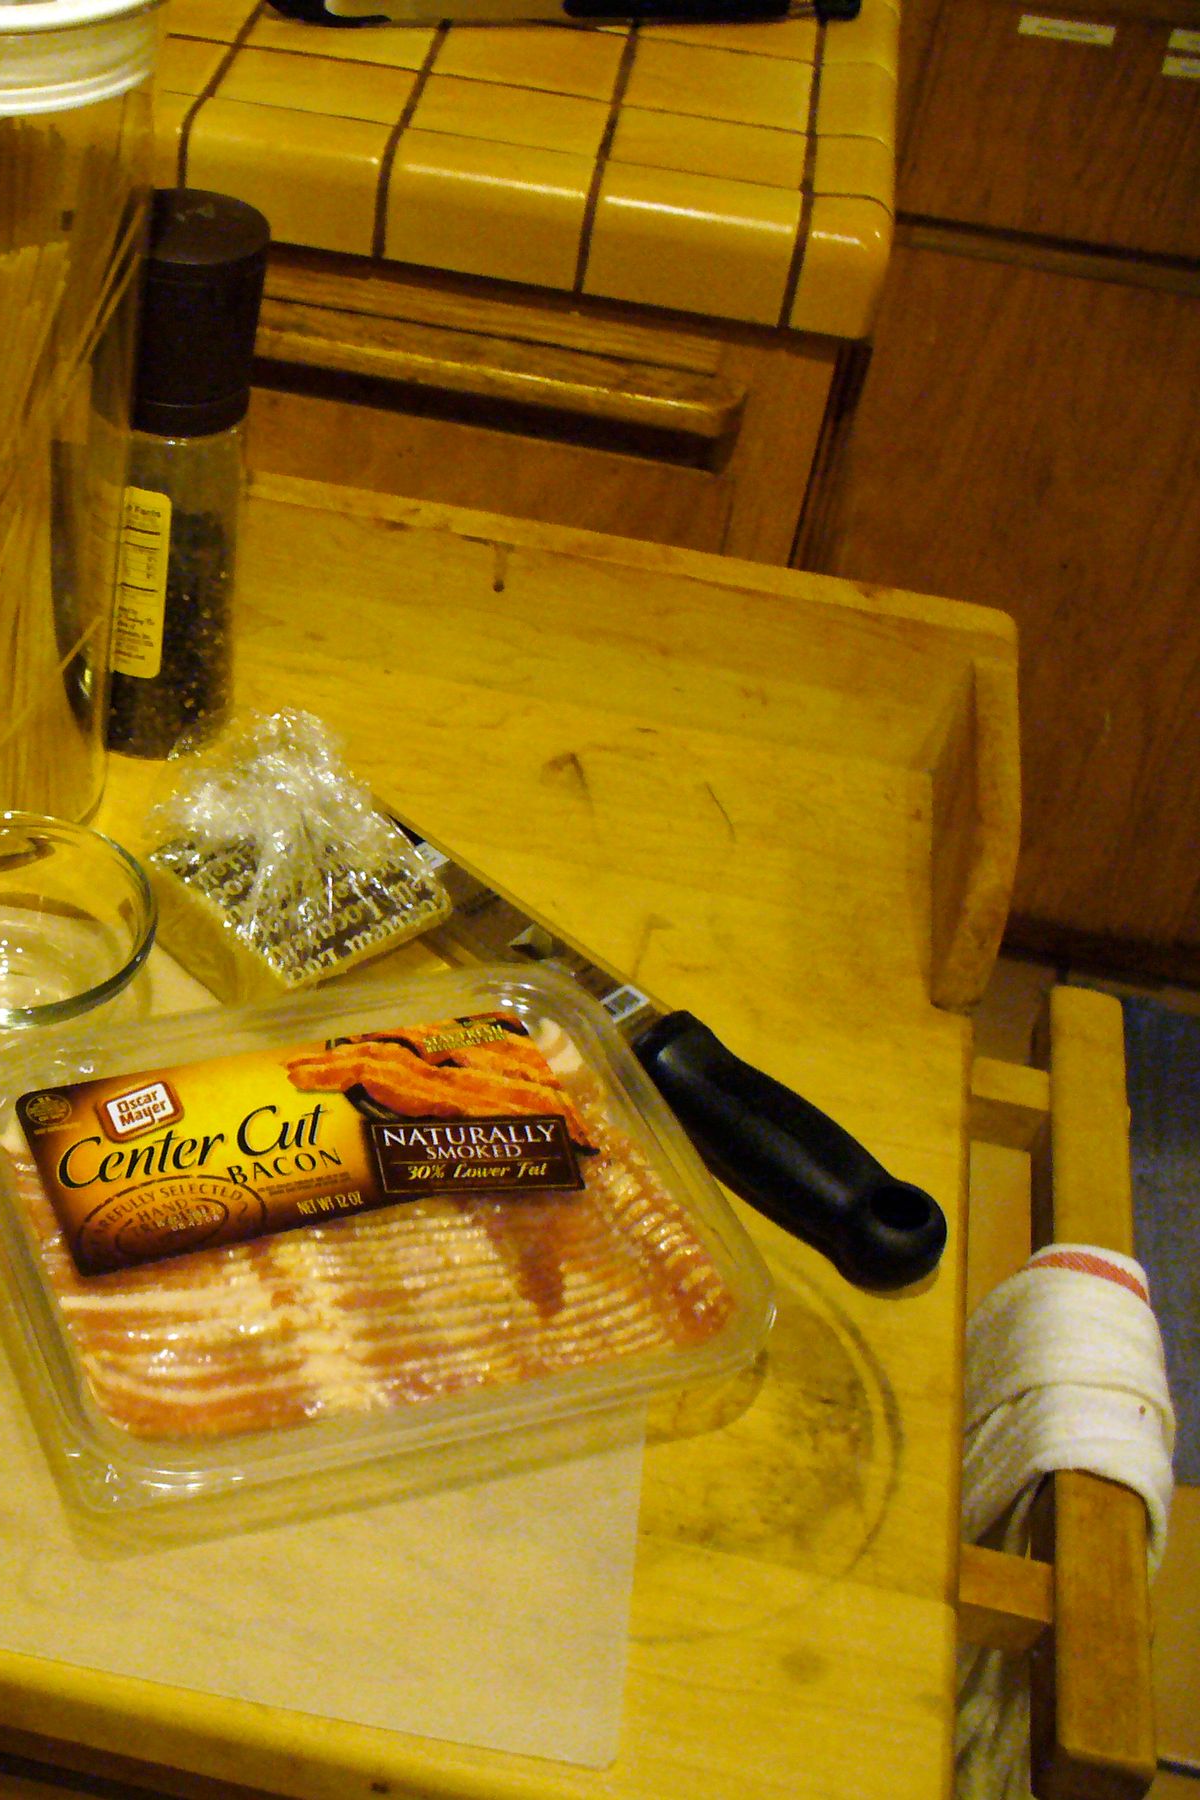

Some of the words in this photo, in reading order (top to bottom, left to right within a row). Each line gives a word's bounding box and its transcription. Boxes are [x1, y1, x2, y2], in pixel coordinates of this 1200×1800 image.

[116, 1089, 159, 1114] Oscar
[118, 1100, 168, 1127] Mayer
[58, 1130, 226, 1189] Center
[236, 1104, 329, 1158] Cut
[383, 1123, 555, 1147] NATURALLY
[426, 1144, 522, 1161] SMOKED
[226, 1147, 343, 1186] BACON
[408, 1164, 445, 1181] 30%
[453, 1162, 511, 1179] Lower
[517, 1161, 548, 1179] Fat
[159, 1182, 244, 1201] SELECTED
[136, 1198, 189, 1223] HAND
[296, 1198, 317, 1216] NET
[317, 1195, 335, 1212] WT
